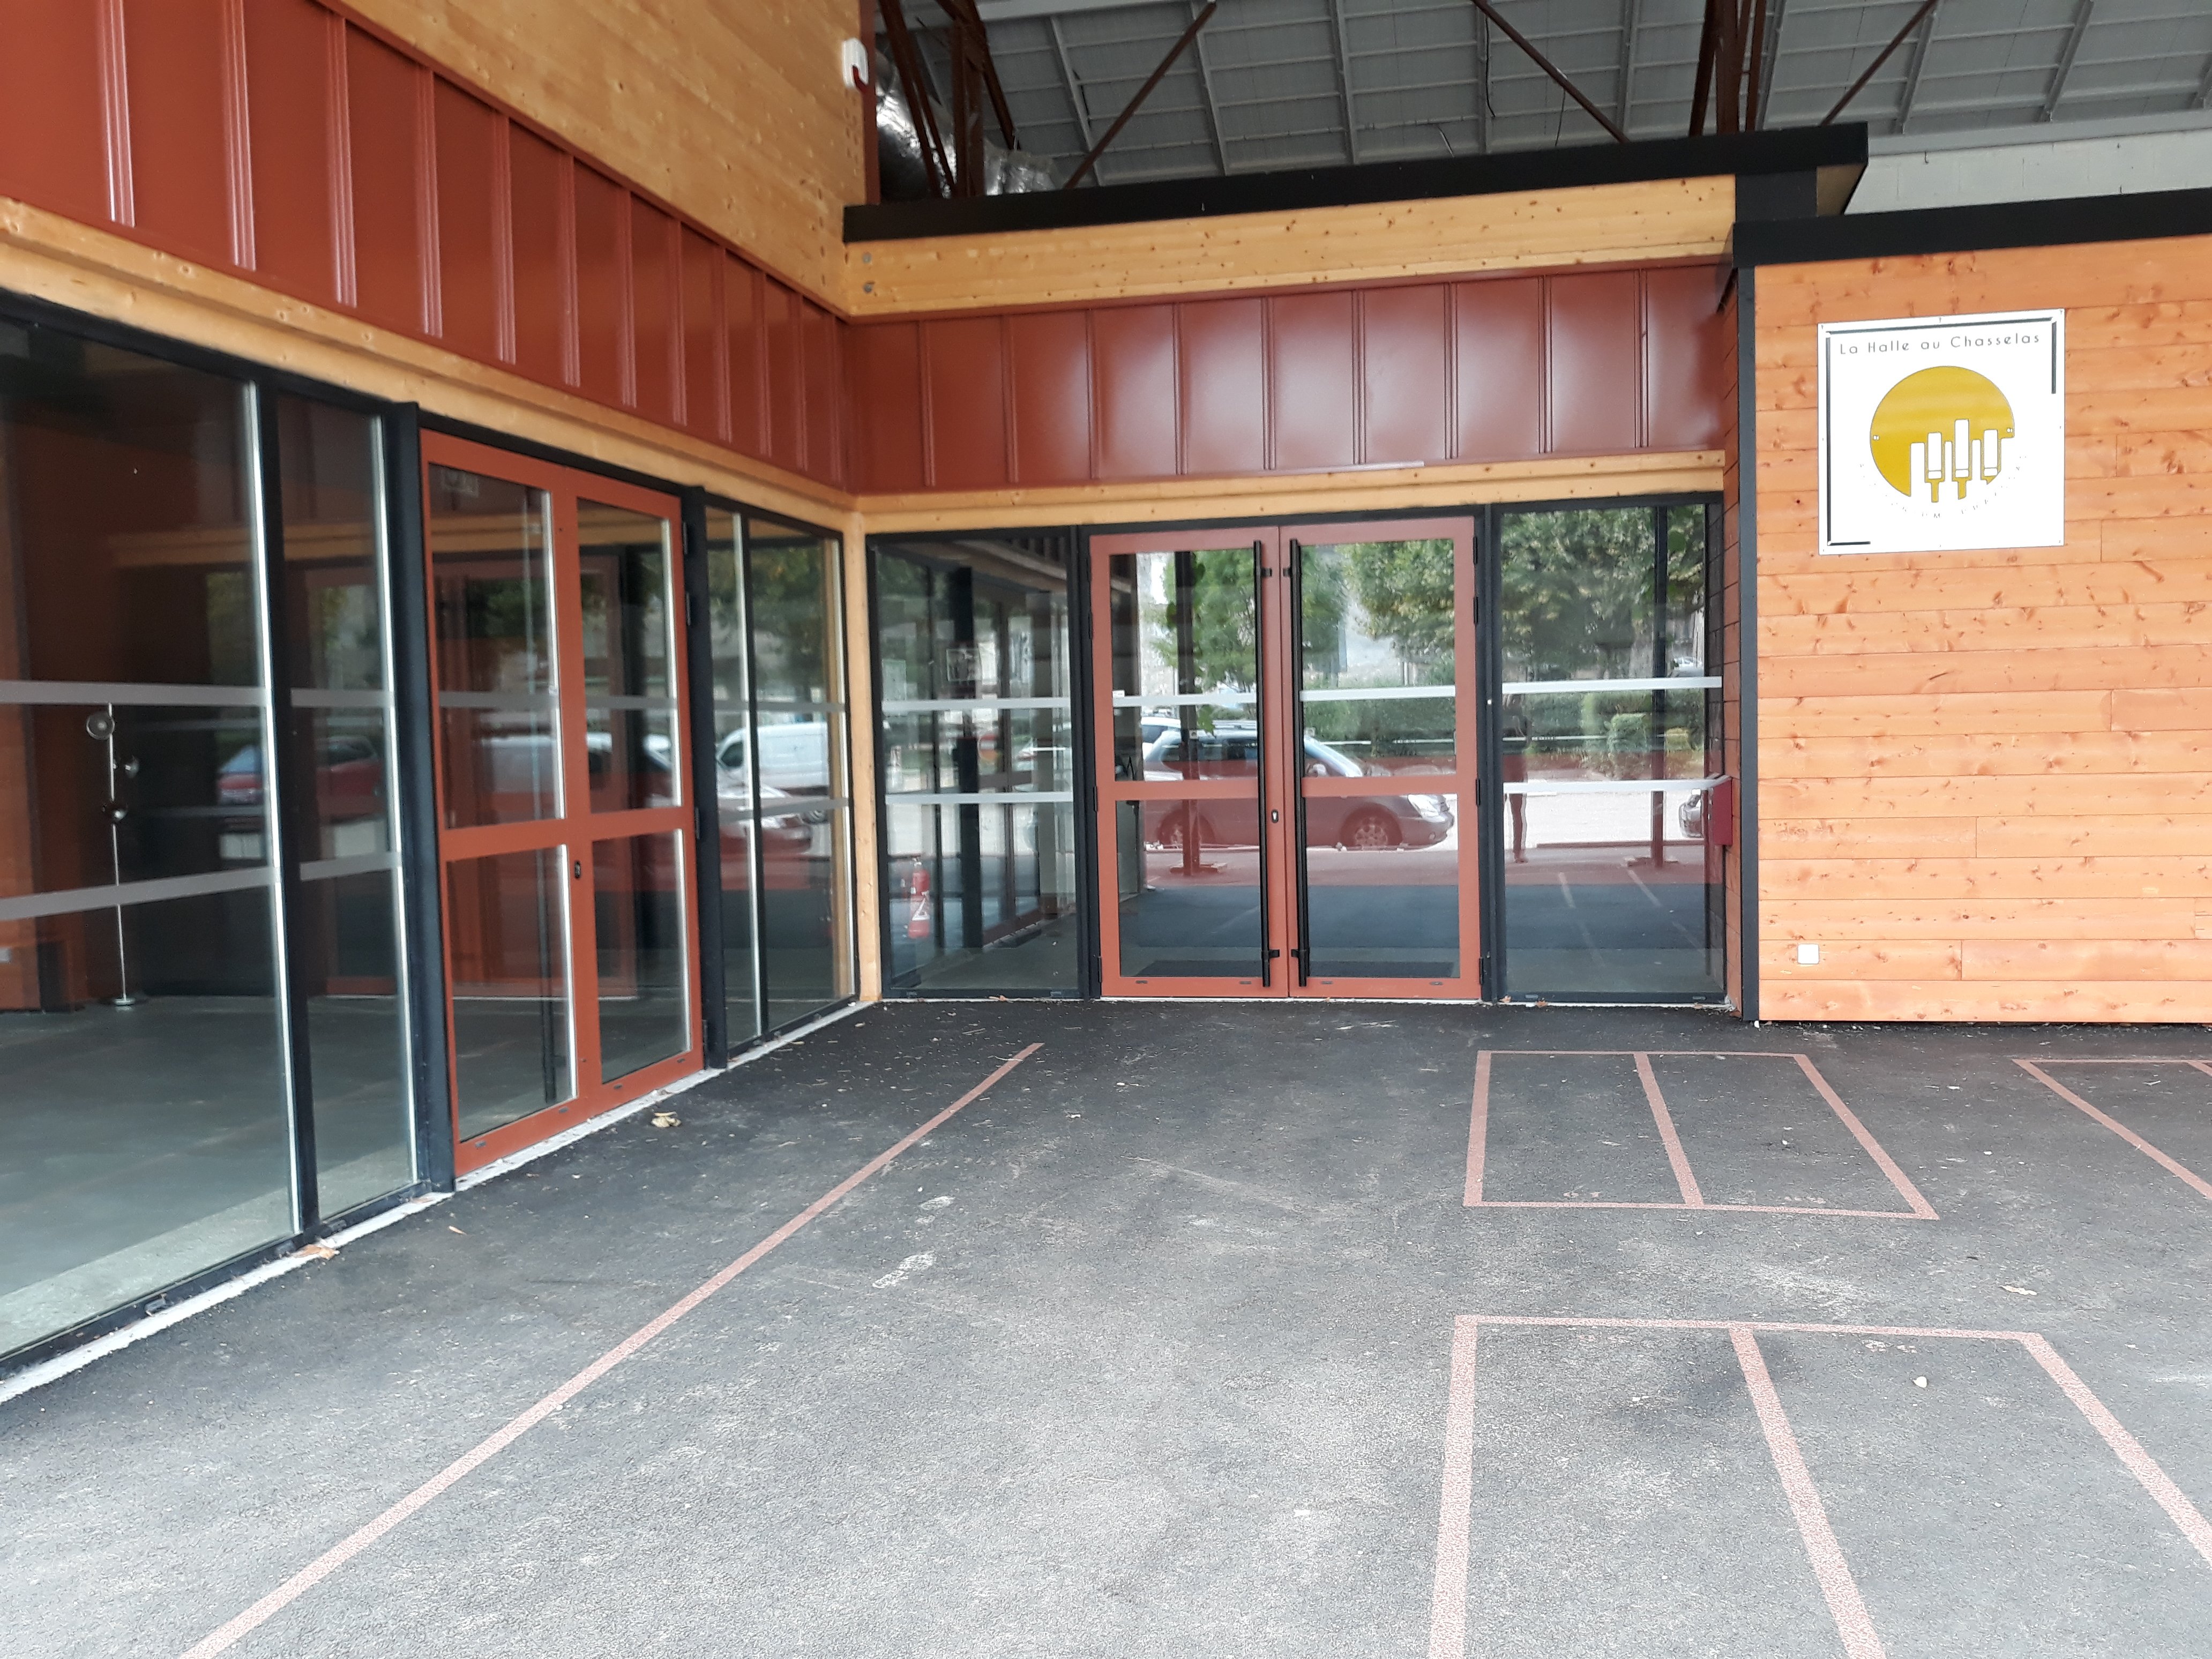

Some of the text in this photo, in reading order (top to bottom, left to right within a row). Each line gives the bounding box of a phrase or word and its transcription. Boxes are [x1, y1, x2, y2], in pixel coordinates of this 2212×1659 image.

[1840, 333, 2039, 355] La Halle au Chasselas
